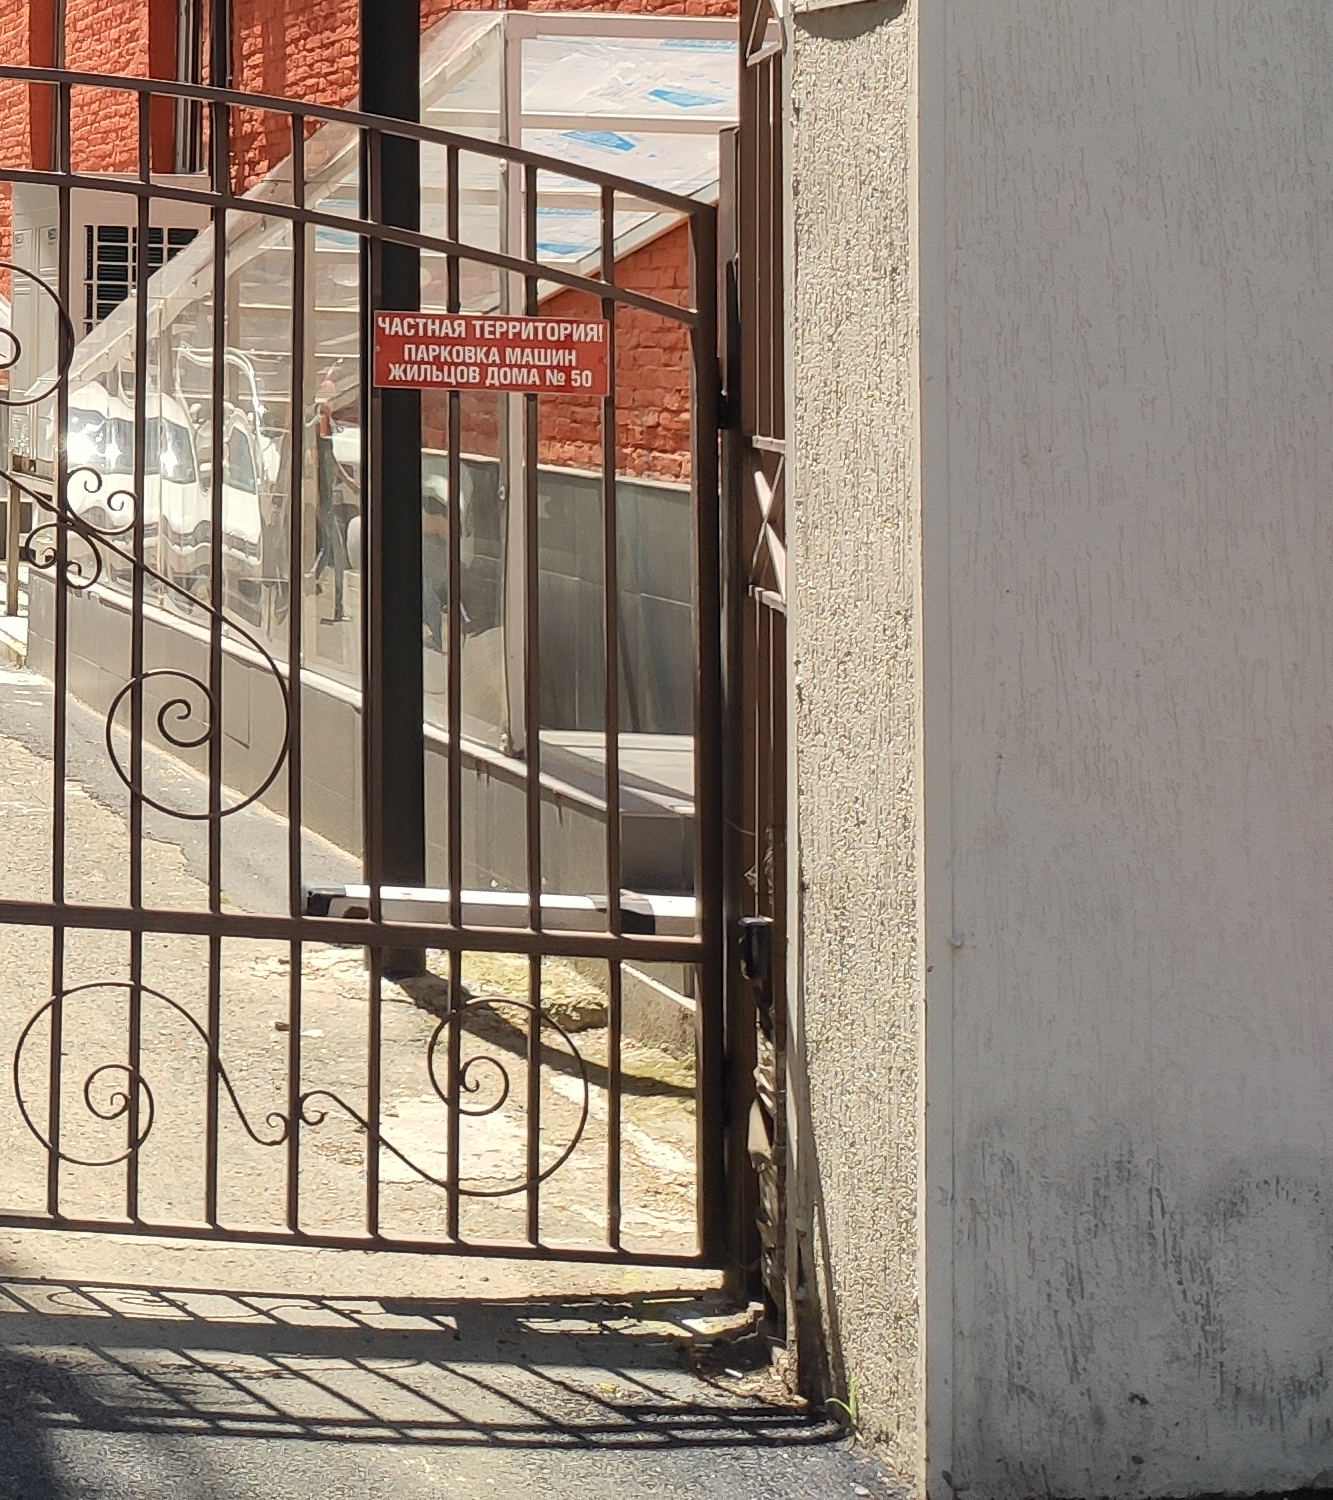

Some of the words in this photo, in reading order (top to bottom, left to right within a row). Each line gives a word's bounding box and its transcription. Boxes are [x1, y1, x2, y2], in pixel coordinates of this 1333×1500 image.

[377, 316, 466, 338] ЧАСТНАЯ
[471, 319, 604, 342] ТЕРРИТОРИЯ!
[403, 344, 501, 365] ПАРКОВКА
[505, 347, 577, 367] МАШИН
[387, 363, 481, 386] ЖИЛЬЦОВ
[485, 367, 541, 387] ДОМА
[545, 368, 566, 386] №
[570, 369, 592, 388] 50
